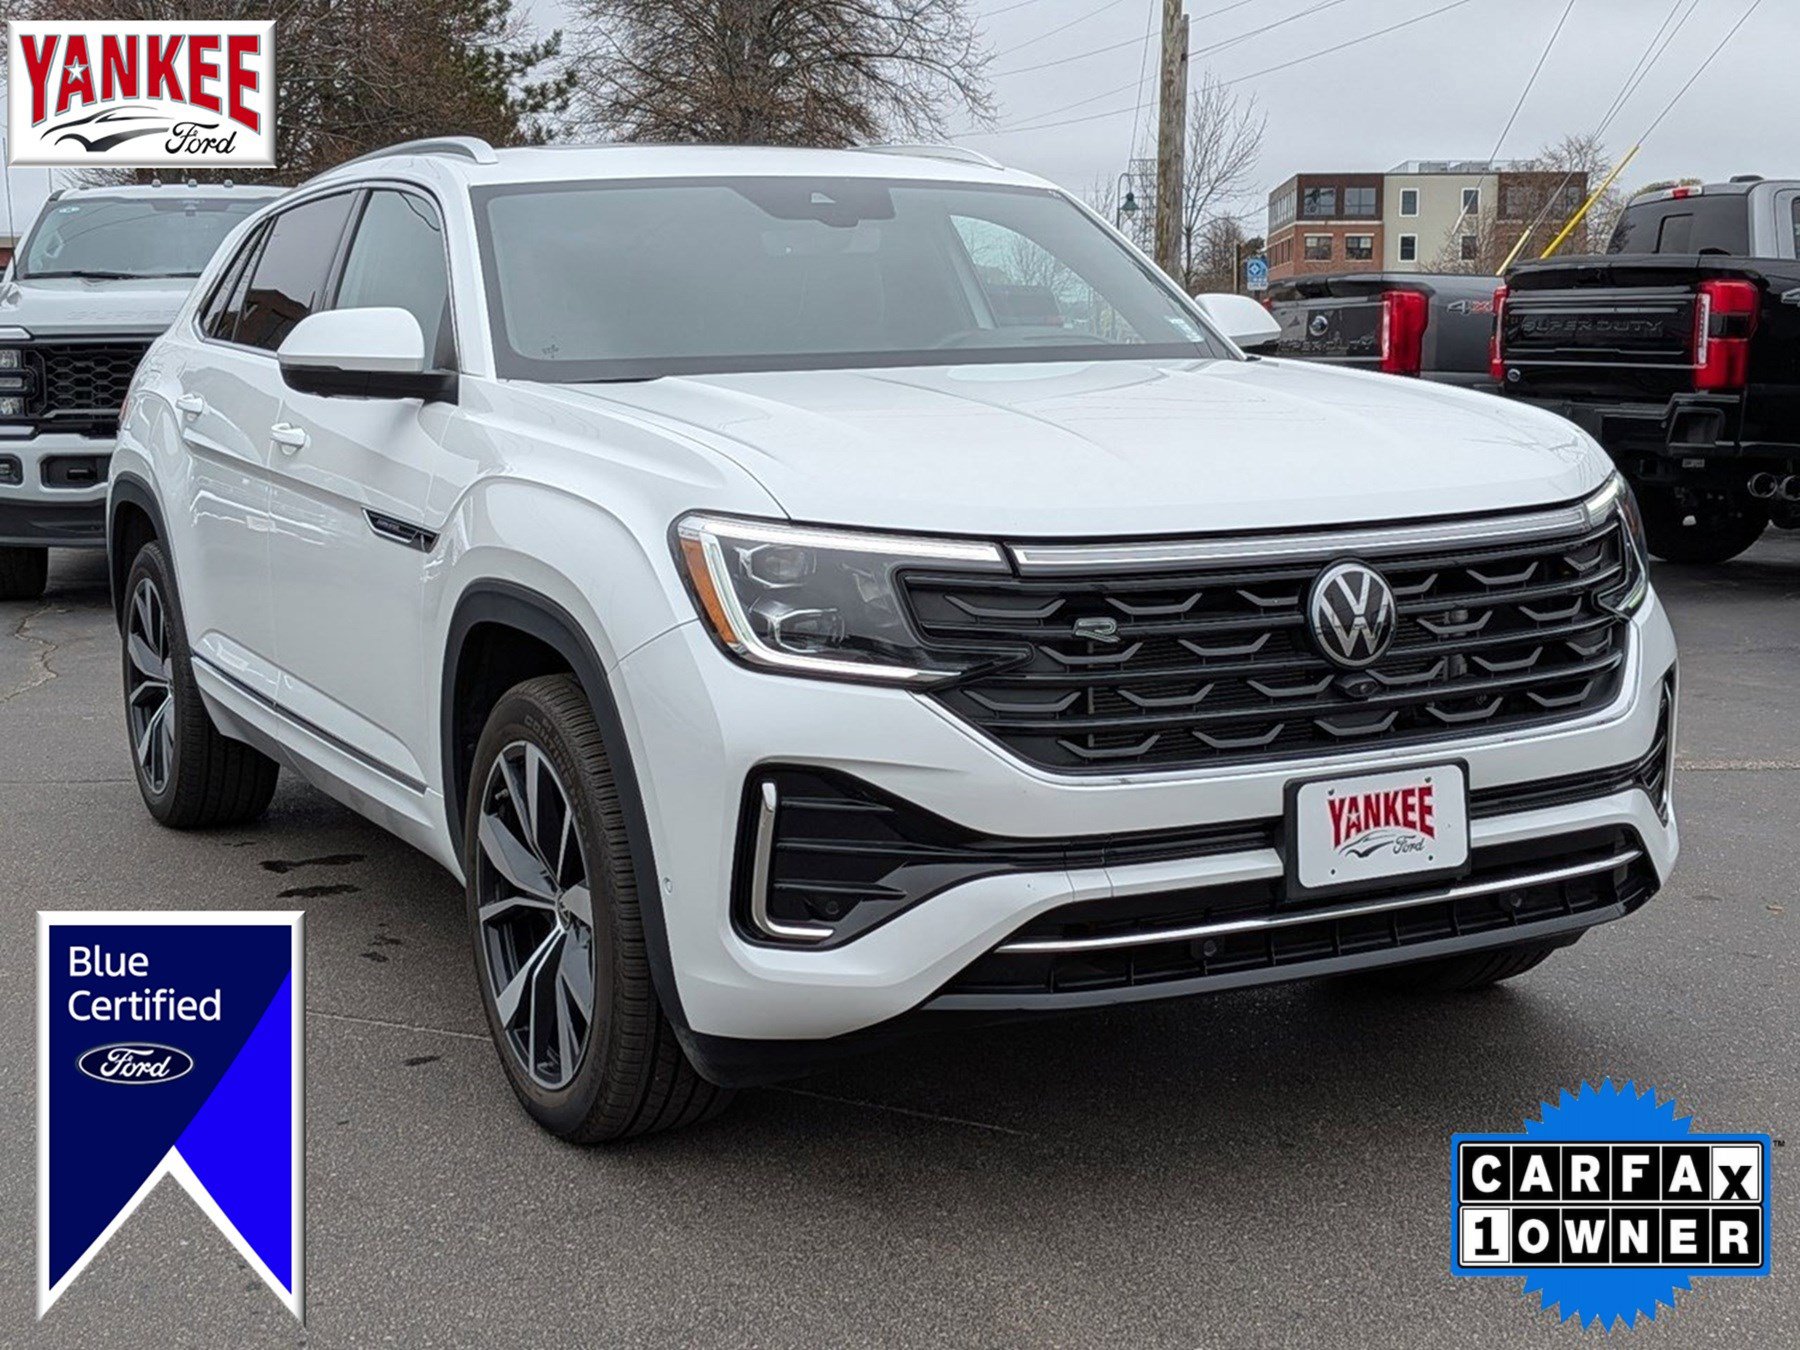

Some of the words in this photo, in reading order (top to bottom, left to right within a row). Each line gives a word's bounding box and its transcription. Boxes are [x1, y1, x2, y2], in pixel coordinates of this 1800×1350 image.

[1522, 320, 1593, 332] SUPER
[1596, 320, 1662, 332] DUTY
[1327, 784, 1435, 848] YANKEE
[1393, 835, 1426, 855] Ford
